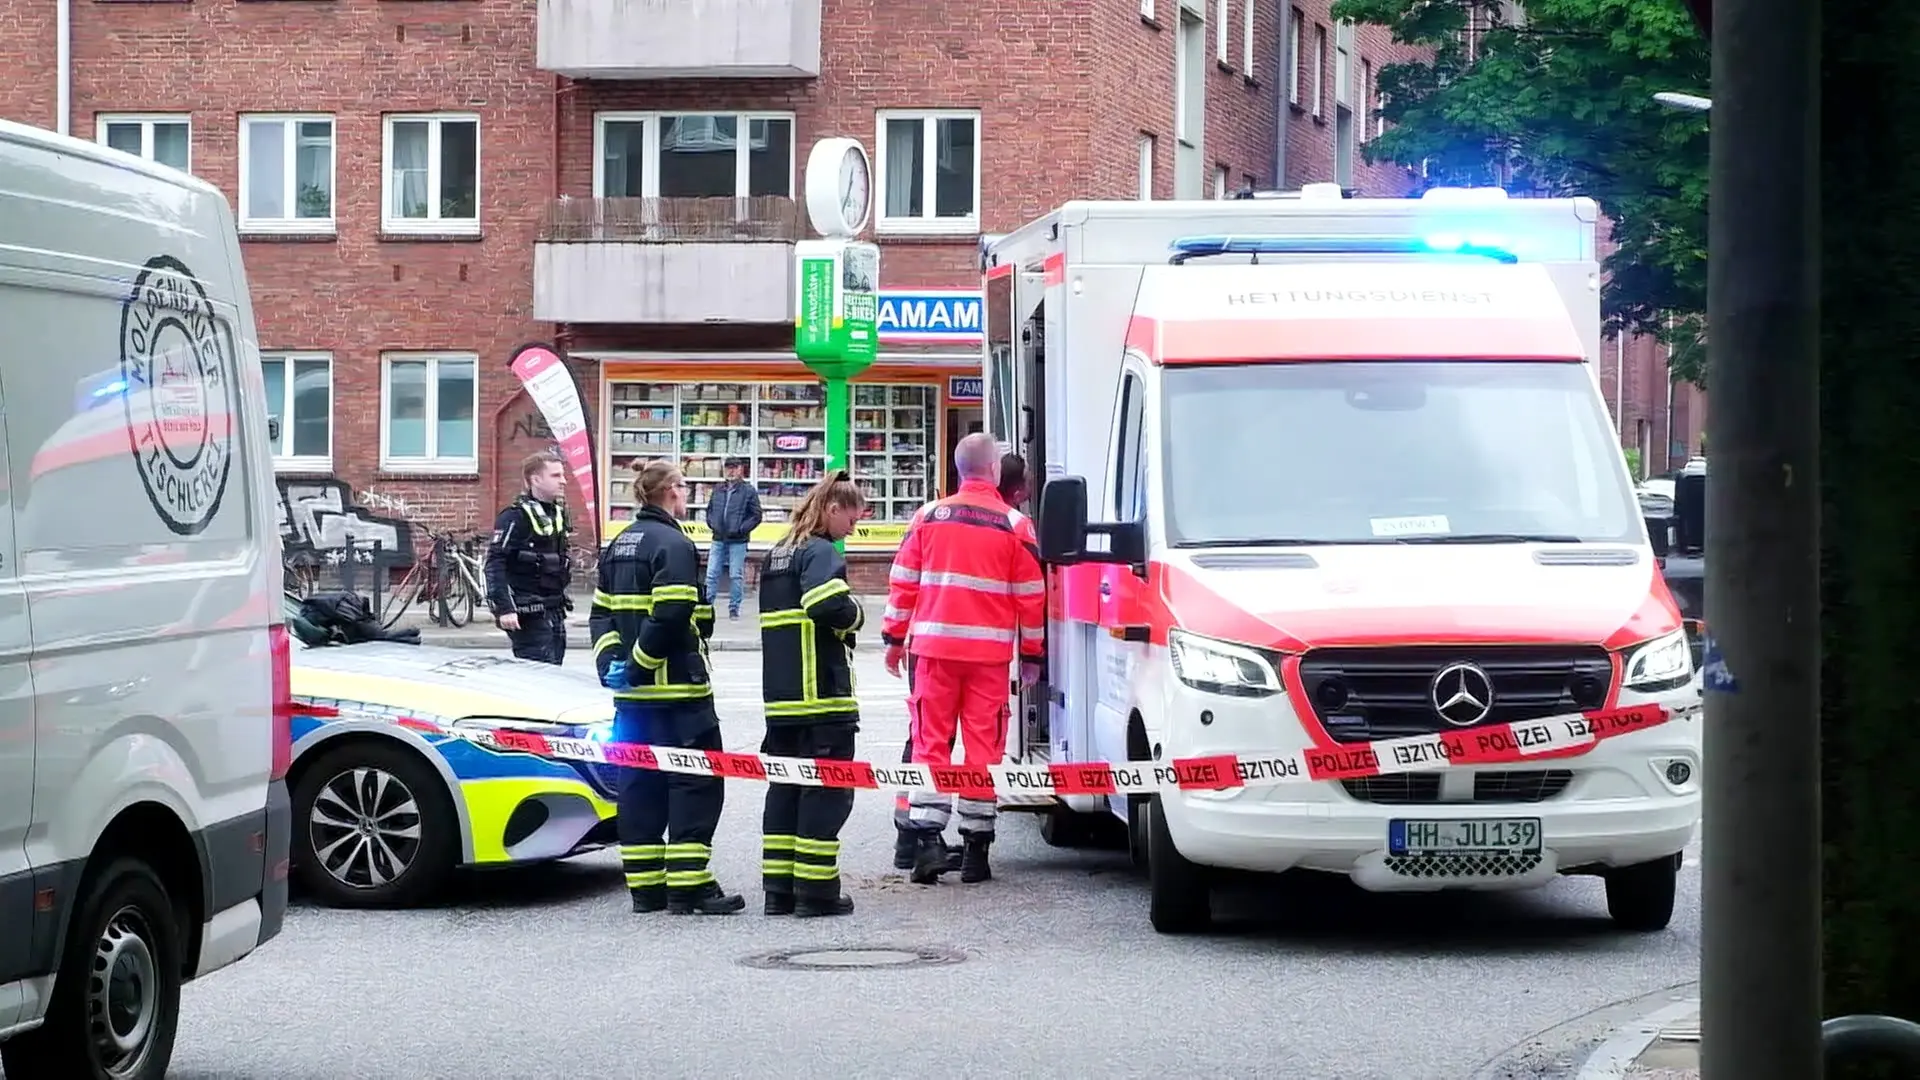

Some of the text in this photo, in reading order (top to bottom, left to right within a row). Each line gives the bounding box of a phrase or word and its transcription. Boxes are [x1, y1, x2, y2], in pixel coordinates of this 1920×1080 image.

[1228, 289, 1492, 305] RETTUNGSDIENST
[141, 426, 224, 512] TISCHLEREI
[604, 745, 658, 765] POLIZEI
[668, 753, 722, 771] POLIZEI
[732, 759, 788, 779] POLIZEI
[799, 764, 855, 783] POLIZEI
[867, 768, 924, 787] POLIZEI
[937, 766, 994, 788] POLIZEI
[1007, 770, 1067, 790] POLIZEI
[1081, 769, 1142, 788] POLIZEI
[1154, 764, 1220, 787] POLIZEI
[1234, 757, 1299, 781] POLIZEI
[1311, 749, 1378, 777] POLIZEI
[1393, 737, 1465, 765] POLIZEI
[1477, 726, 1552, 756] POLIZEI
[1407, 822, 1536, 847] HH JU 139
